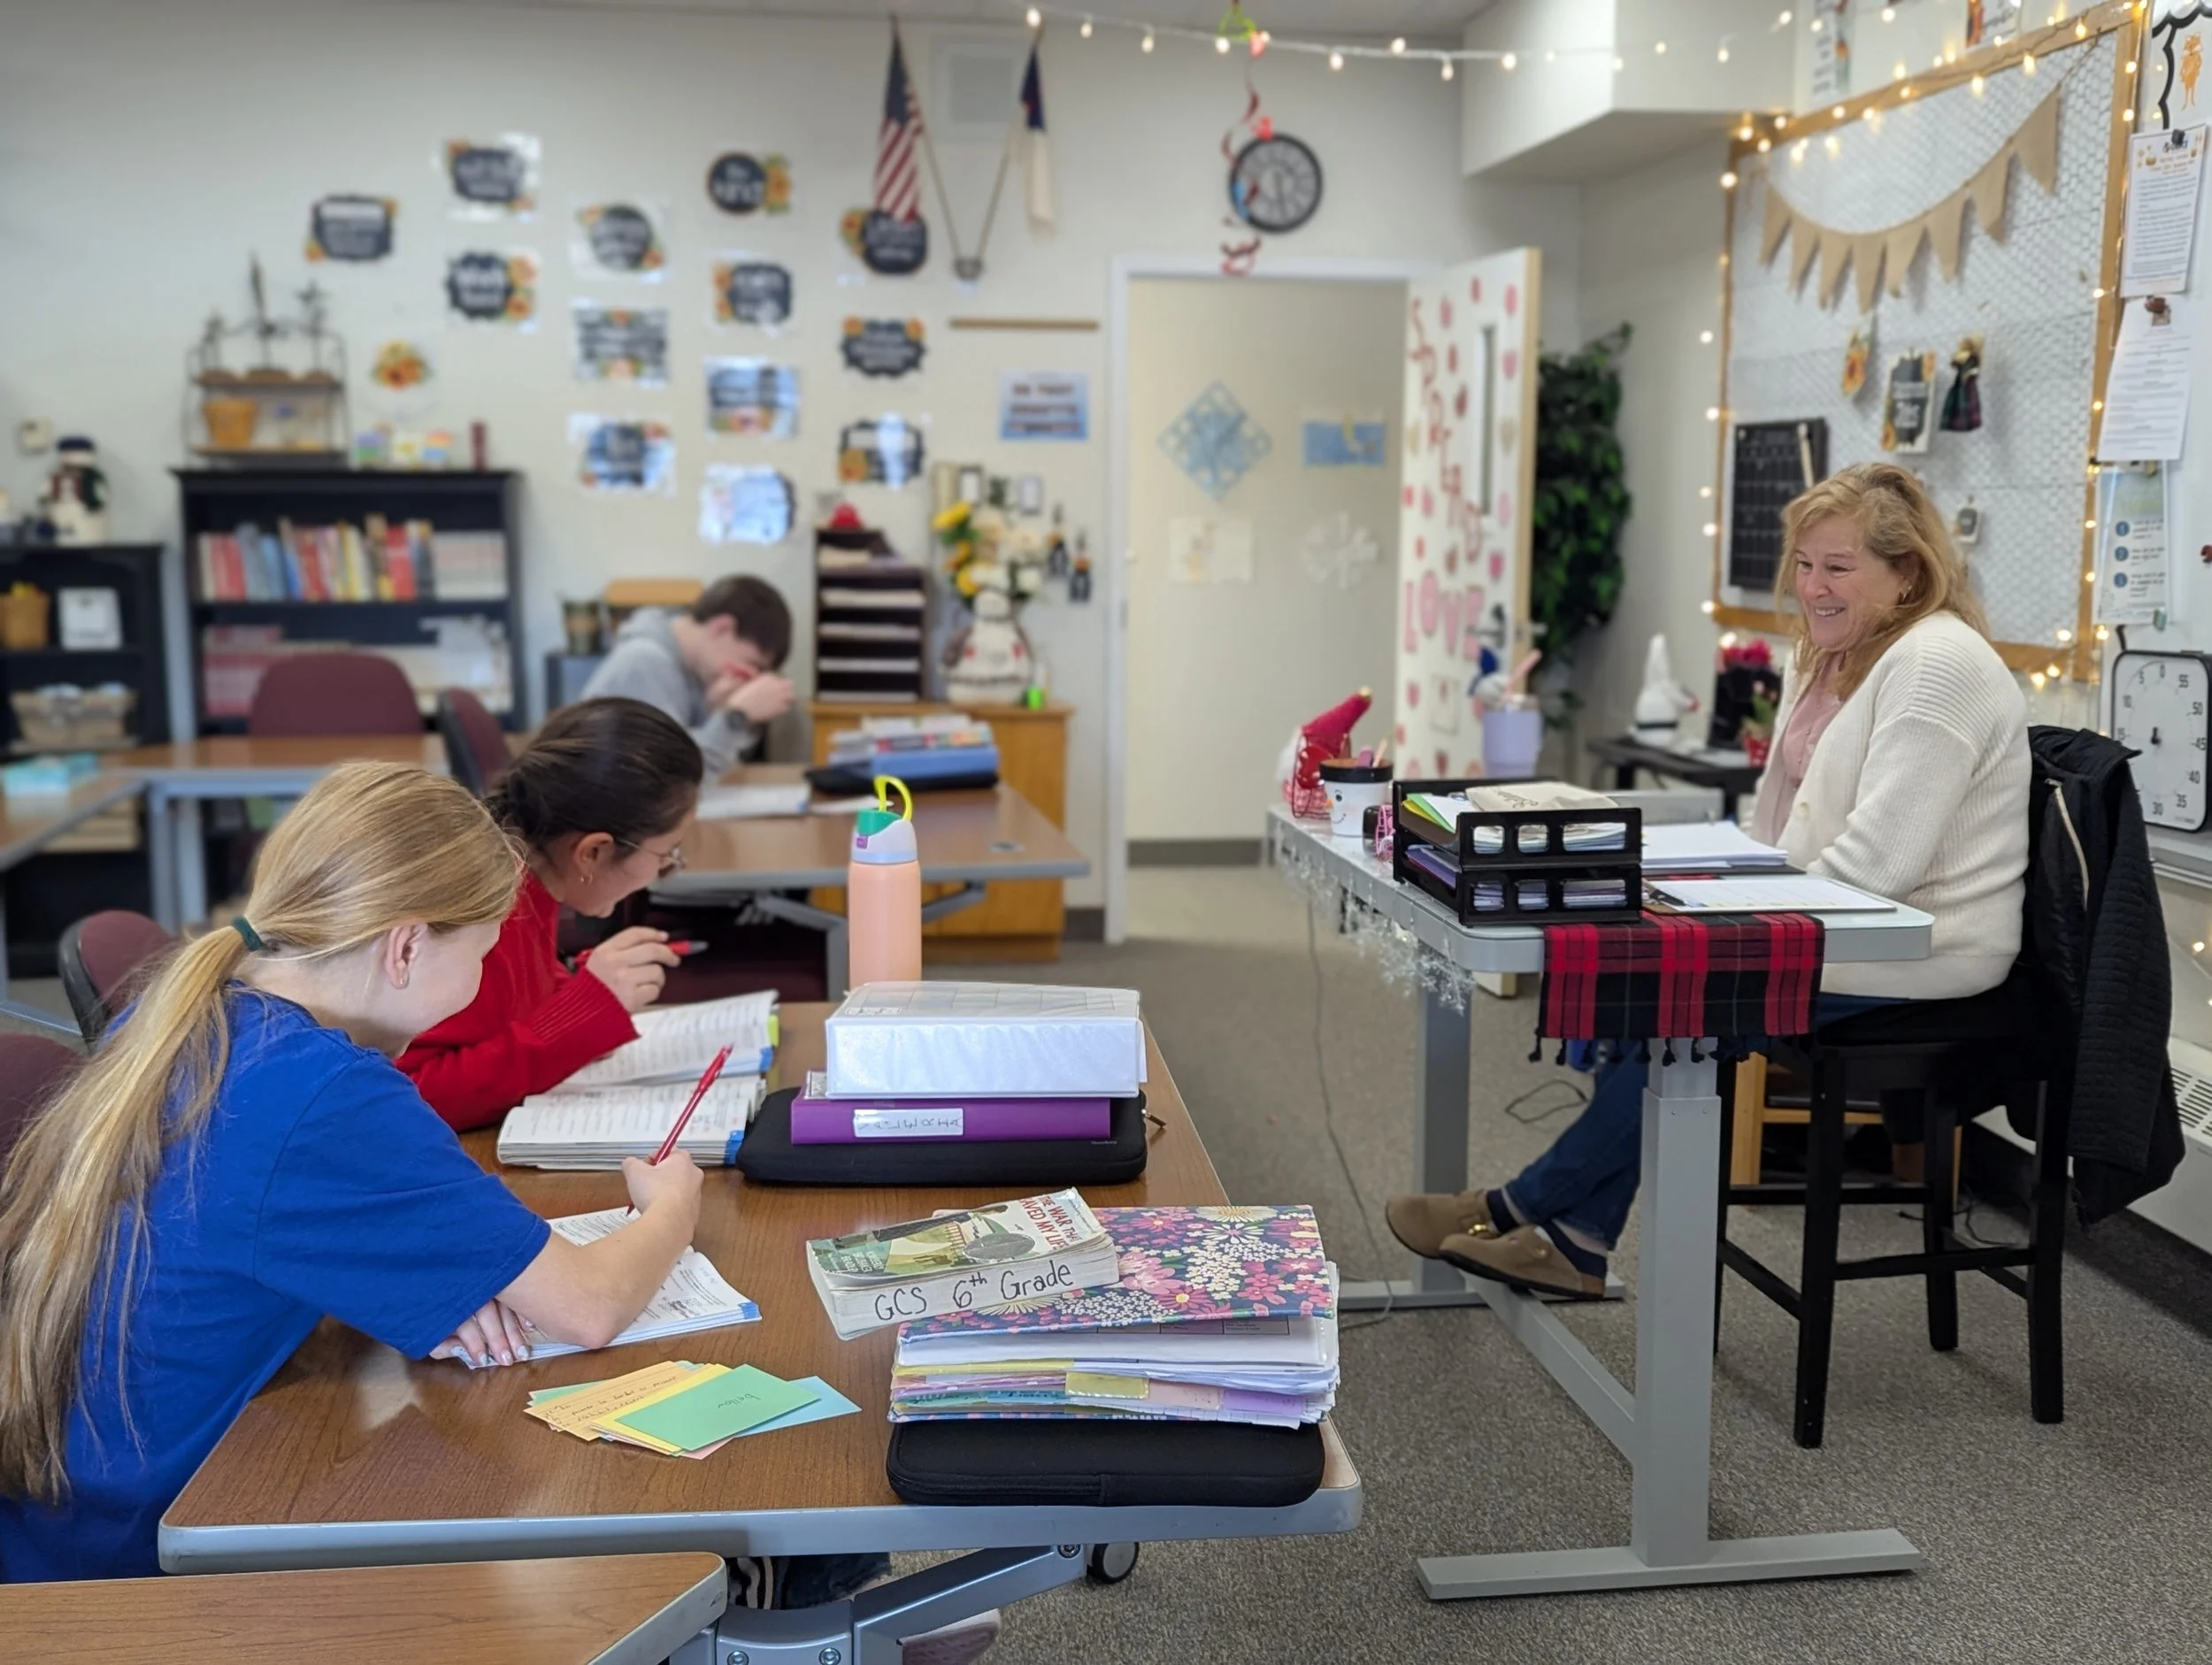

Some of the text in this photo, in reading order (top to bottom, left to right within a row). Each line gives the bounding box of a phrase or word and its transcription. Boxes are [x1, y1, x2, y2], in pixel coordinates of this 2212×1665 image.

[1404, 569, 1484, 662] LOVE
[2139, 671, 2145, 684] 5
[2159, 665, 2166, 679] 0
[2178, 674, 2189, 688] 55
[2123, 695, 2131, 709] 10
[2192, 702, 2203, 715] 50
[2195, 737, 2207, 750] 45
[2189, 771, 2200, 784] 40
[2176, 794, 2187, 809] 35
[2152, 802, 2163, 816] 30
[1040, 1195, 1056, 1208] THE
[1049, 1206, 1072, 1227] WAR
[1036, 1220, 1058, 1234] MY
[874, 1259, 1073, 1322] GCS 6th Grade
